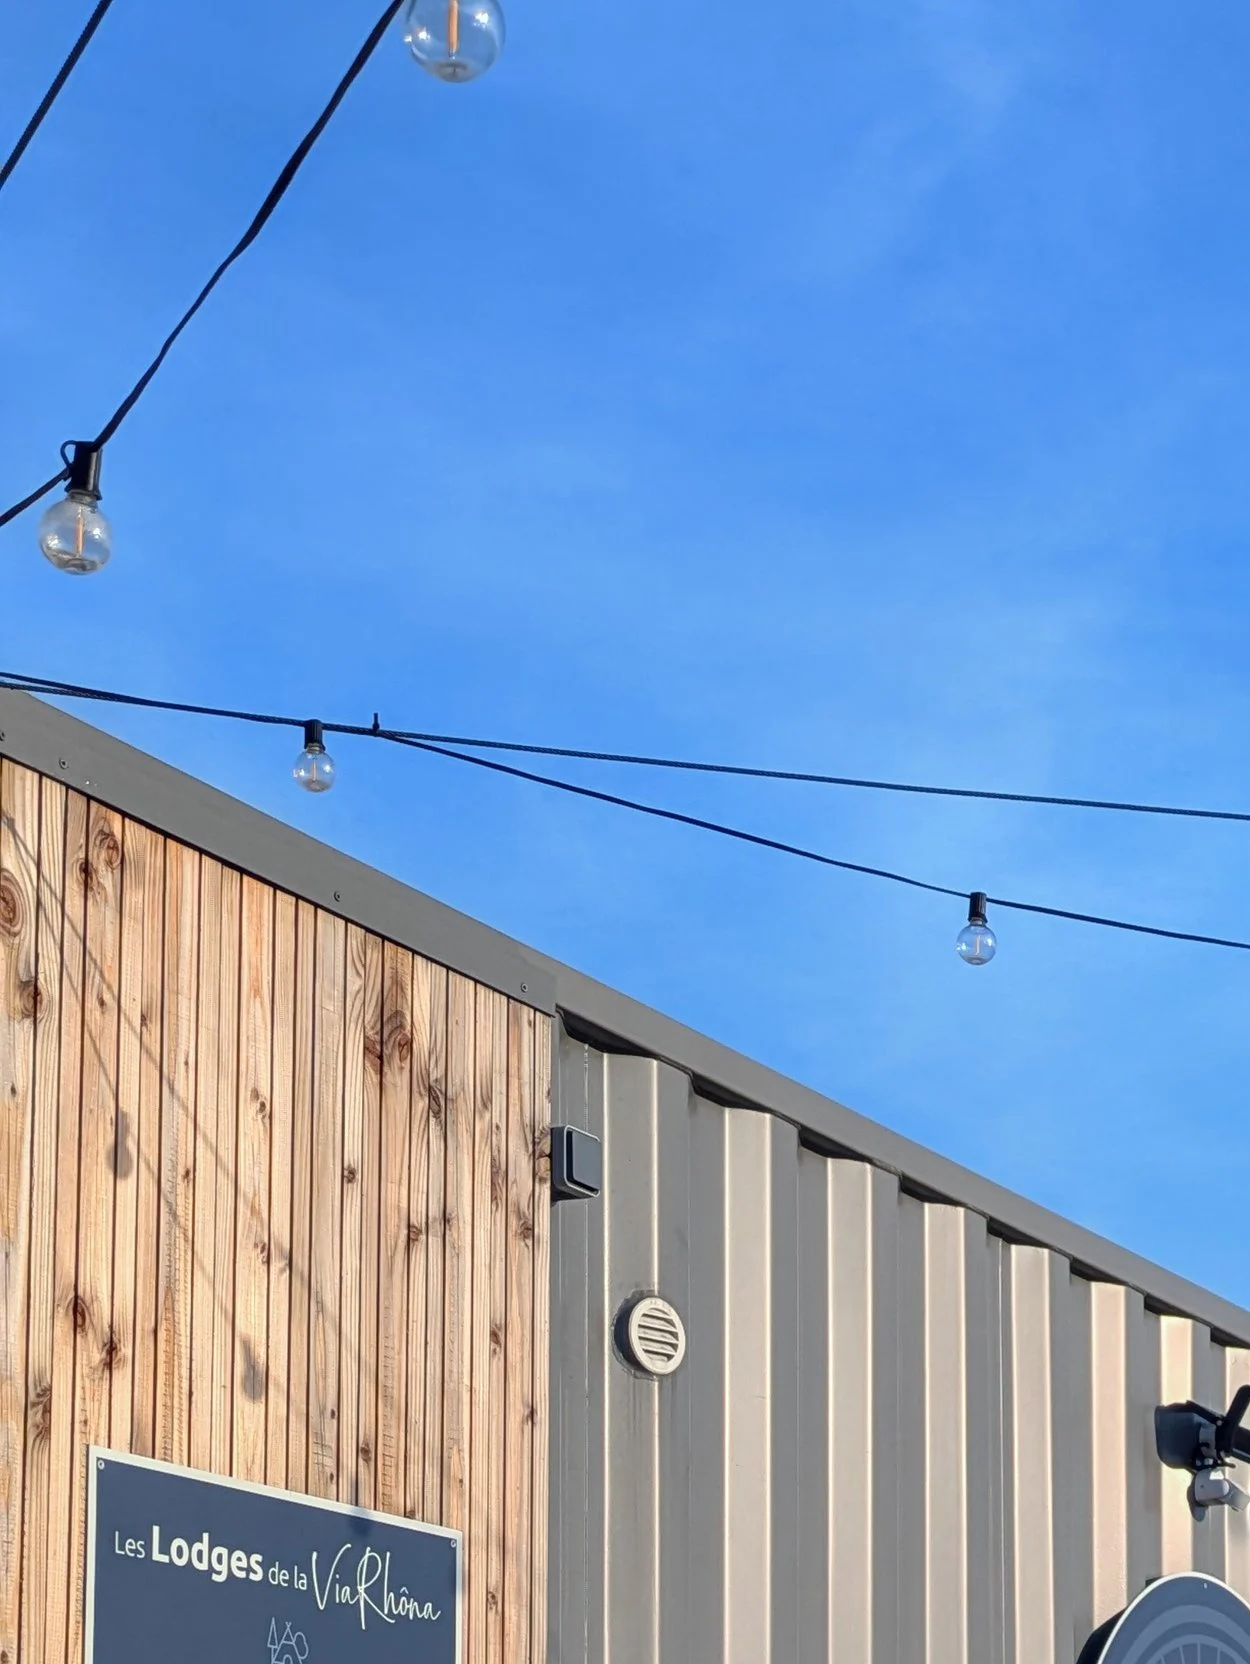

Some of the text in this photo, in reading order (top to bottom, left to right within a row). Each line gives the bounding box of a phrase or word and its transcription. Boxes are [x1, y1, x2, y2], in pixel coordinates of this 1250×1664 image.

[115, 1525, 441, 1629] Les Lodges de la ViaRhôna
